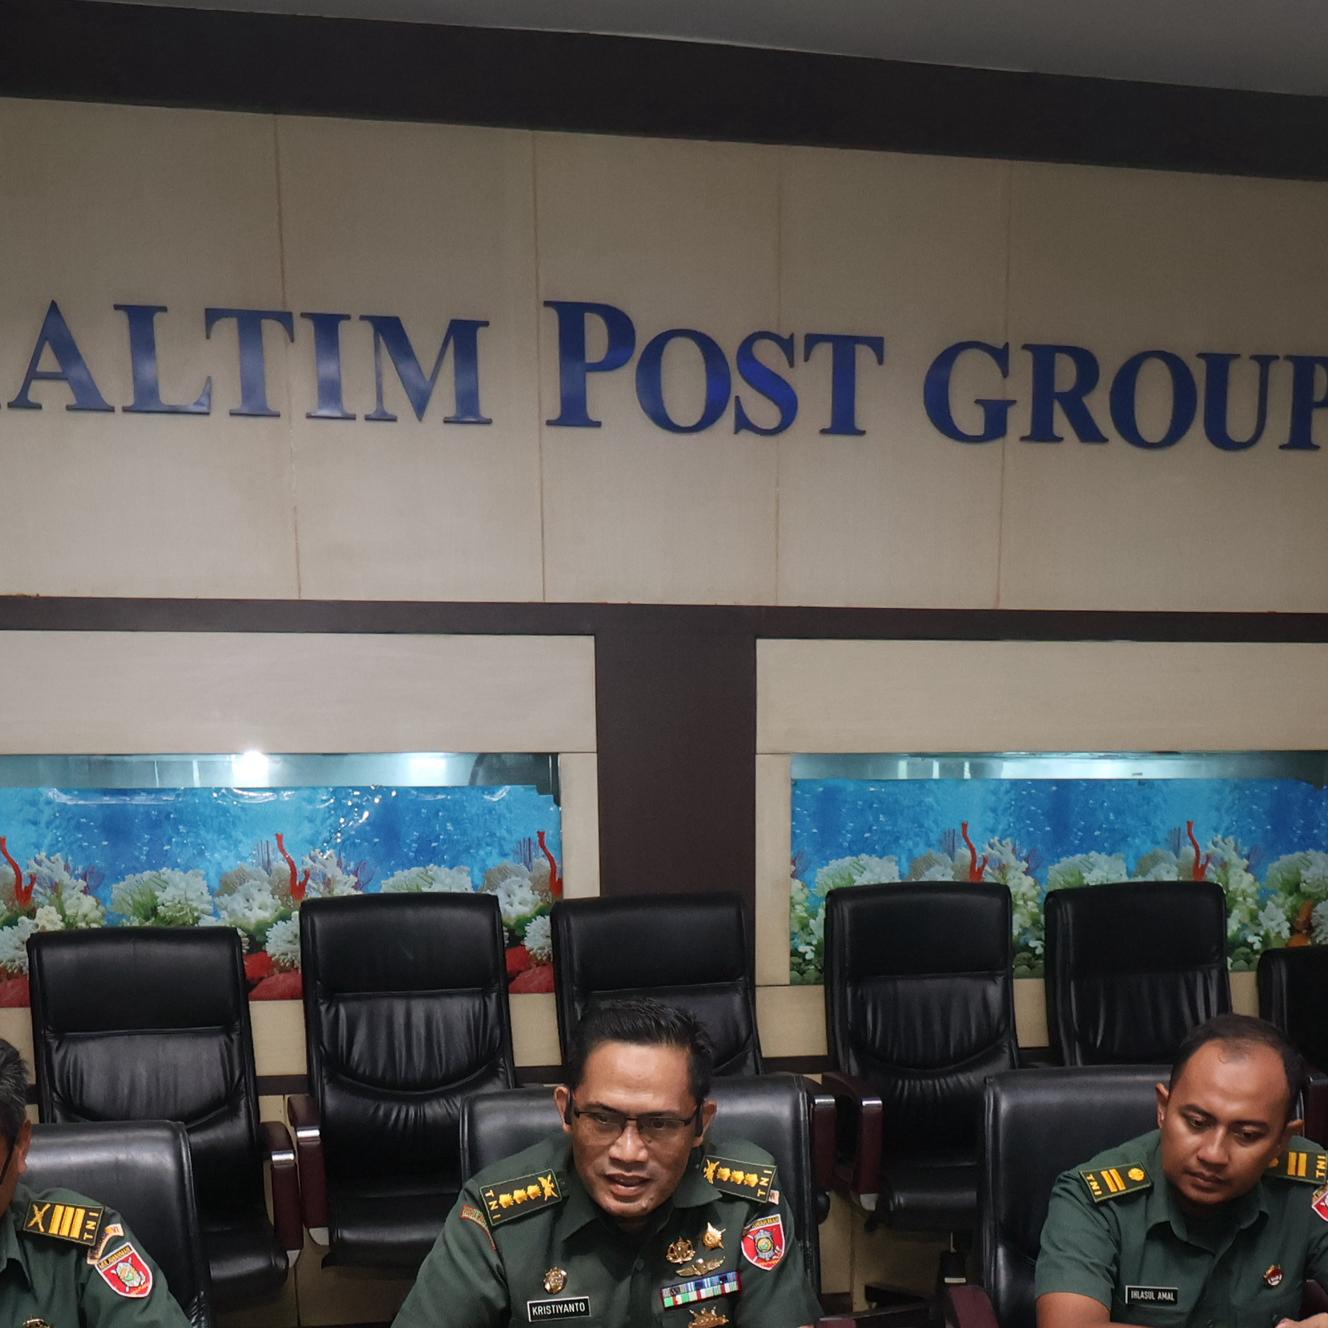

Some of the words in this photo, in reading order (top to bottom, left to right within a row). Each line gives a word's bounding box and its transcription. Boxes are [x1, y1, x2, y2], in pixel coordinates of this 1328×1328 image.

[542, 300, 884, 437] POST
[1316, 1155, 1326, 1178] TNI
[757, 1170, 773, 1198] TNI
[1087, 1174, 1102, 1195] TNI
[485, 1189, 501, 1220] TNI
[83, 1212, 99, 1240] TNI
[1157, 1291, 1175, 1301] AMAL
[532, 1302, 586, 1316] KRISTIYANTO
